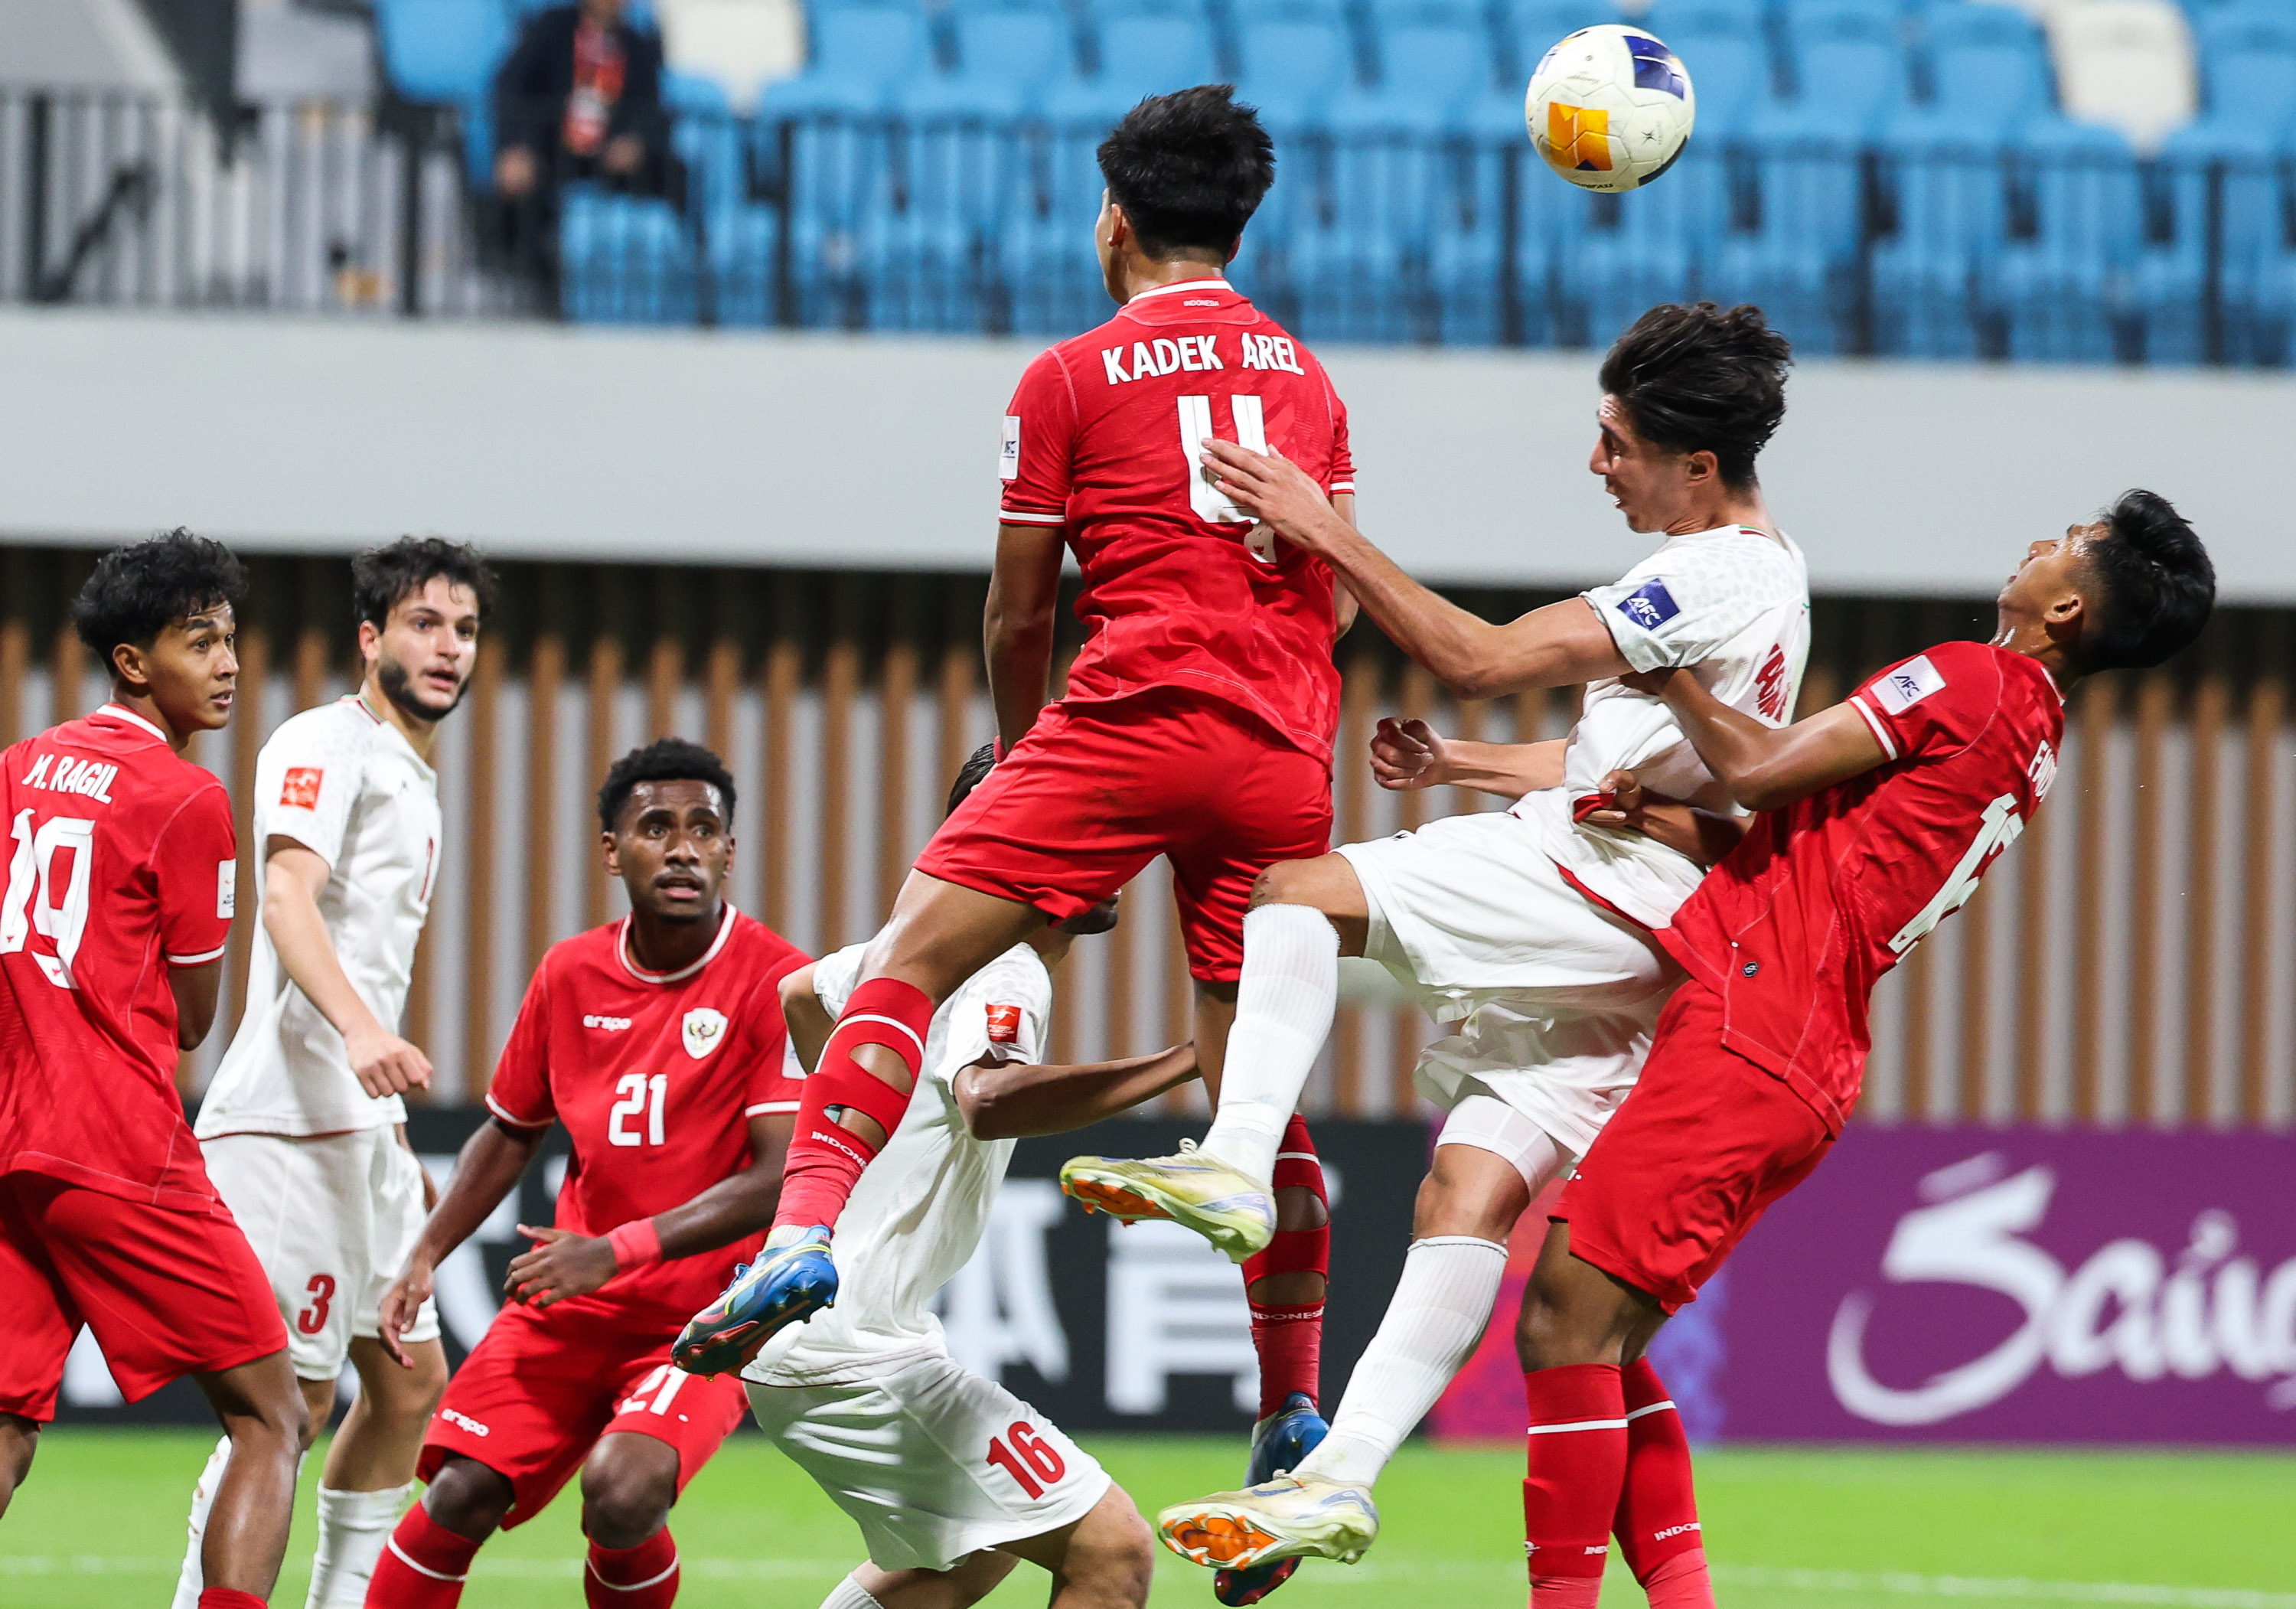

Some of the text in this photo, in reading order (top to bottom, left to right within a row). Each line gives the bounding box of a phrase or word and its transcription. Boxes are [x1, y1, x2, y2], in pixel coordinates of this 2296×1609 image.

[1101, 331, 1306, 385] KADEK AREL
[1176, 394, 1277, 563] 4
[1629, 597, 1662, 626] AFC
[1893, 675, 1921, 697] AFC
[0, 808, 96, 990] 19
[583, 1014, 632, 1033] erspo
[608, 1072, 668, 1147] 21
[298, 1273, 336, 1335] 3
[617, 1363, 690, 1417] 21
[441, 1408, 490, 1437] erspo
[987, 1420, 1066, 1500] 16
